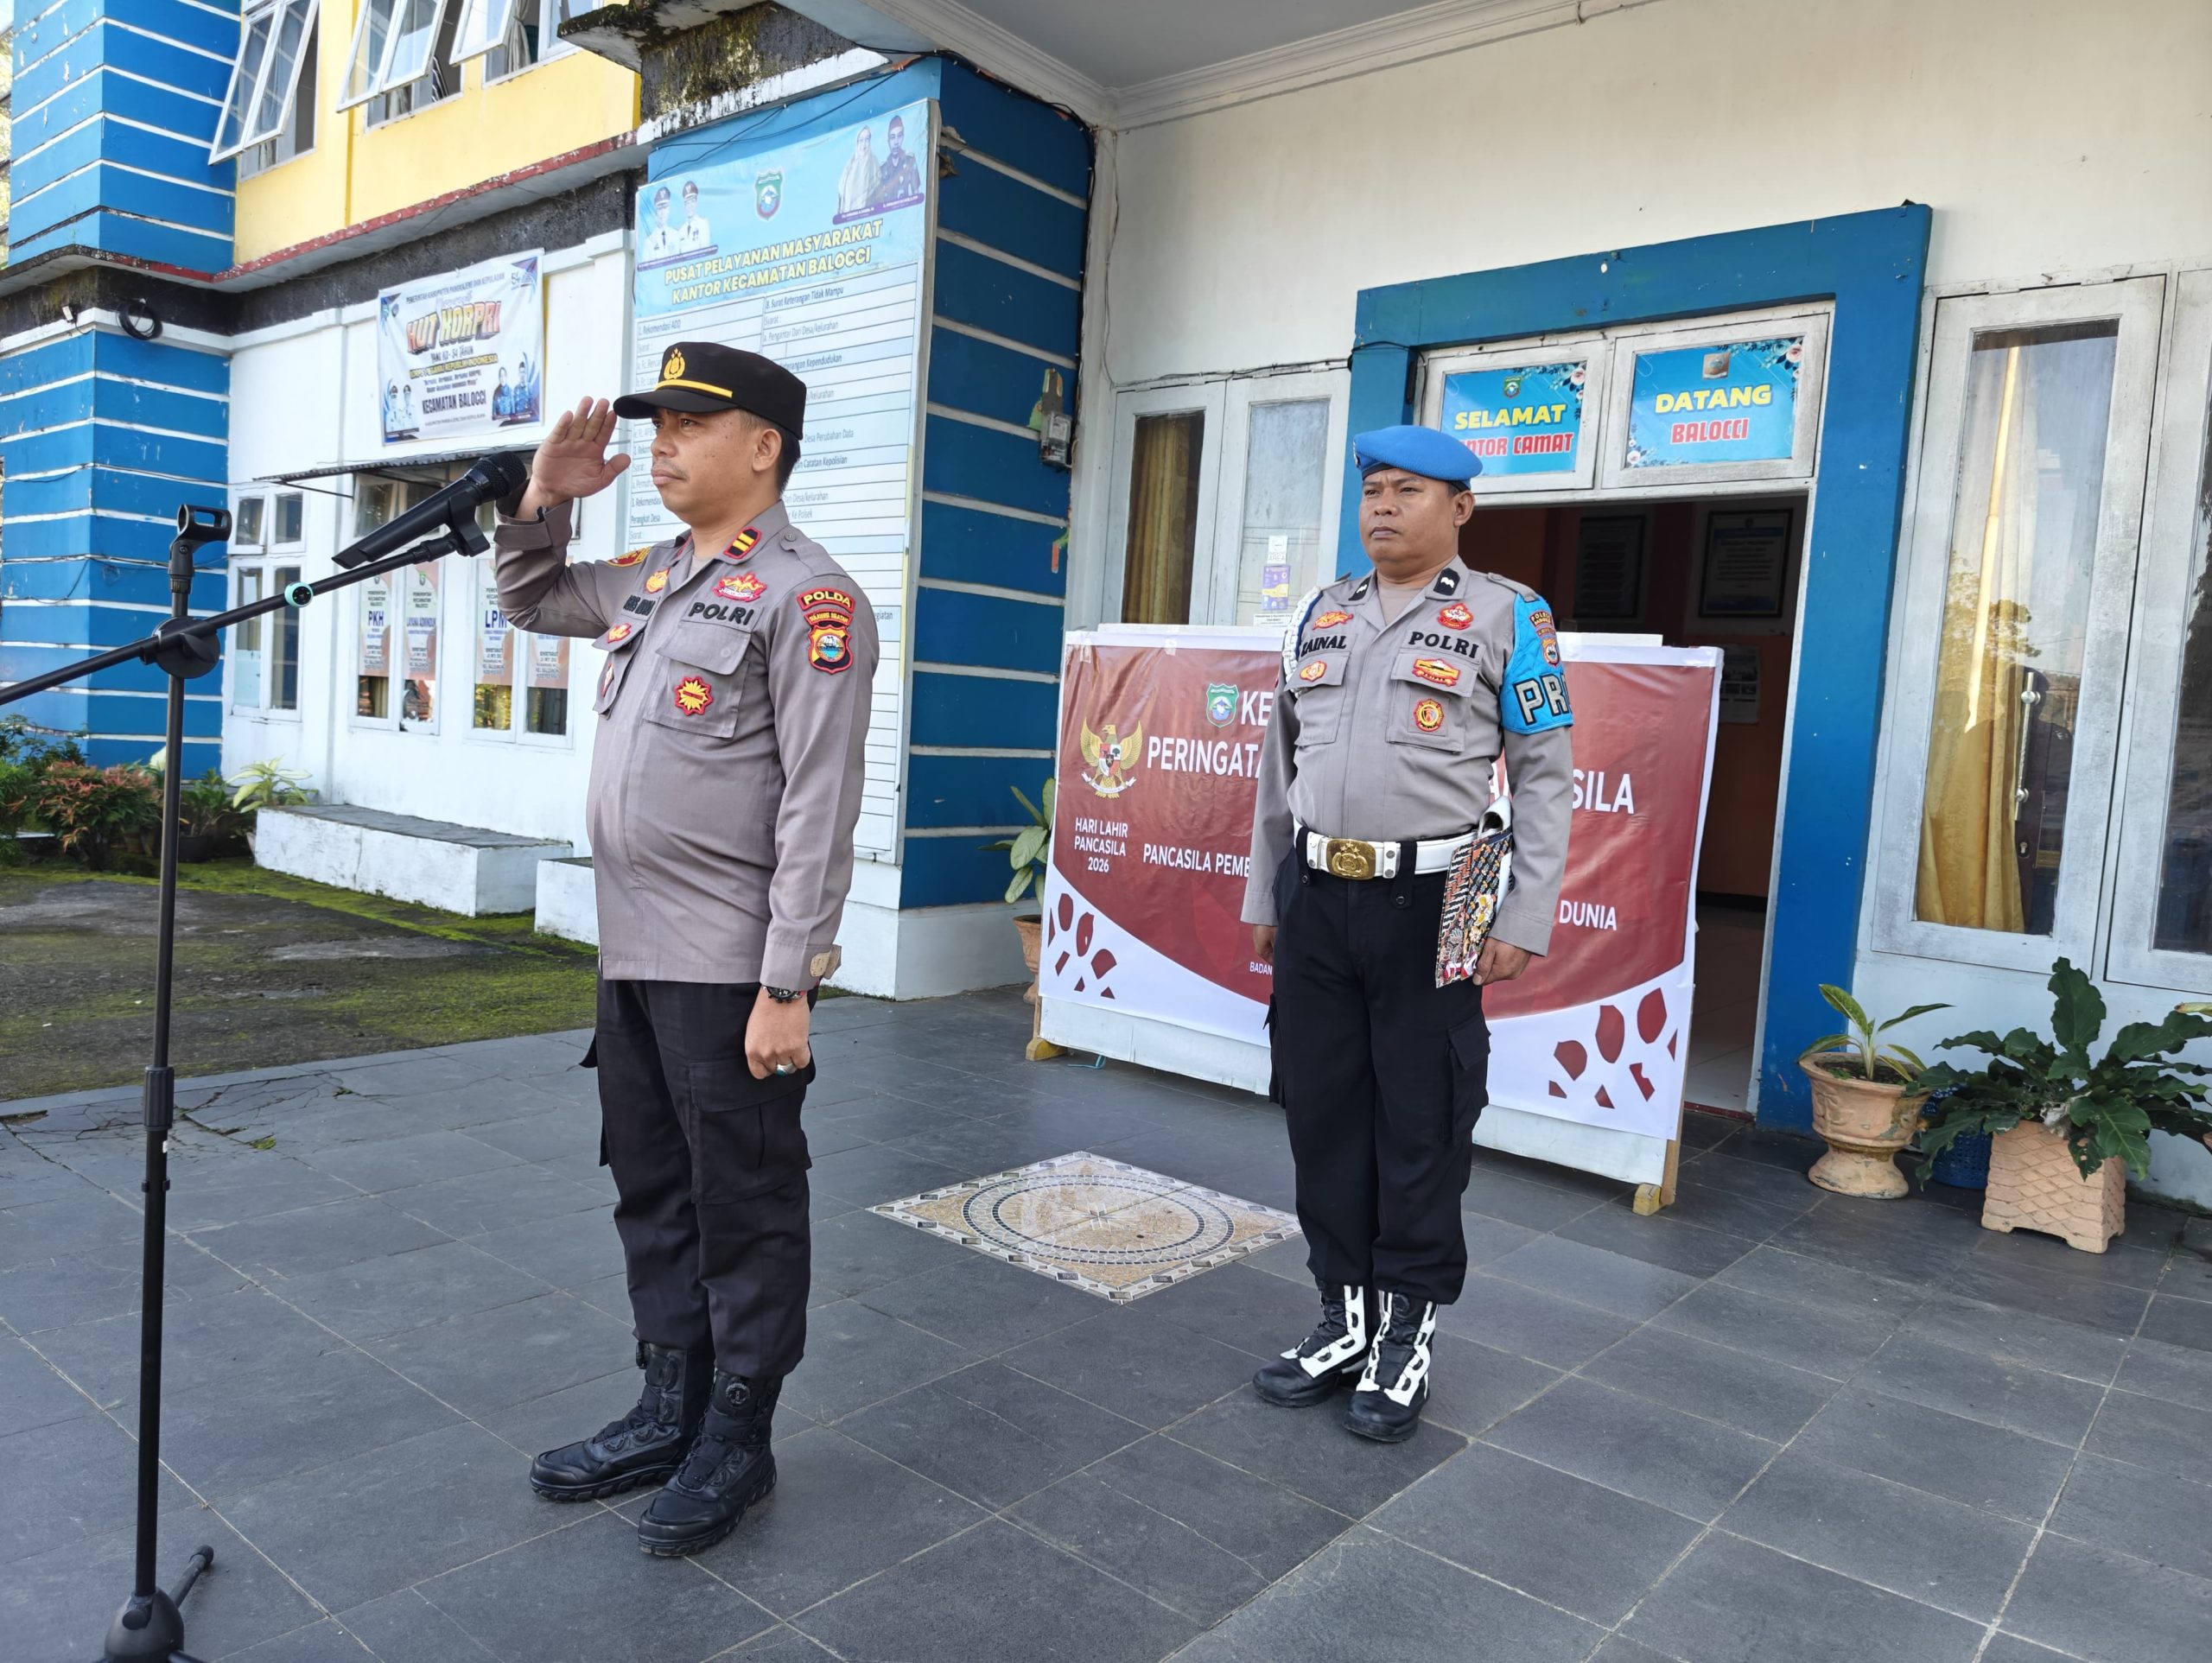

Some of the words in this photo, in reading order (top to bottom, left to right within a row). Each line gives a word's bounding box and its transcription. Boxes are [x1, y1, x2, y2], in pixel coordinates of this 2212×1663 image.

[664, 263, 705, 286] PUSAT
[704, 244, 782, 277] PELAYANAN
[782, 219, 883, 258] MASYARAKAT
[672, 279, 726, 304] KANTOR
[723, 263, 807, 294] KECAMATAN
[808, 245, 871, 276] BALOCCI
[406, 312, 438, 352] HUT
[440, 301, 502, 344] KORPRI
[458, 390, 486, 409] BALOCCI
[1655, 384, 1771, 414] DATANG
[1454, 403, 1567, 430] SELAMAT
[1669, 417, 1751, 445] BALOCCI
[1459, 437, 1508, 457] NTOR
[1514, 433, 1574, 455] CAMAT
[688, 601, 755, 626] POLRI
[804, 591, 851, 609] POLDA
[368, 610, 385, 627] PKH
[1408, 631, 1480, 659] POLRI
[1512, 672, 1572, 727] PR
[1147, 735, 1262, 779] PERINGAT
[1075, 817, 1097, 835] HARI
[1099, 820, 1128, 838] LAHIR
[1074, 835, 1126, 857] PANCASILA
[1142, 843, 1211, 873] PANCASILA
[1087, 856, 1109, 873] 2026
[1558, 899, 1618, 931] DUNIA
[1249, 961, 1273, 975] BADAN
